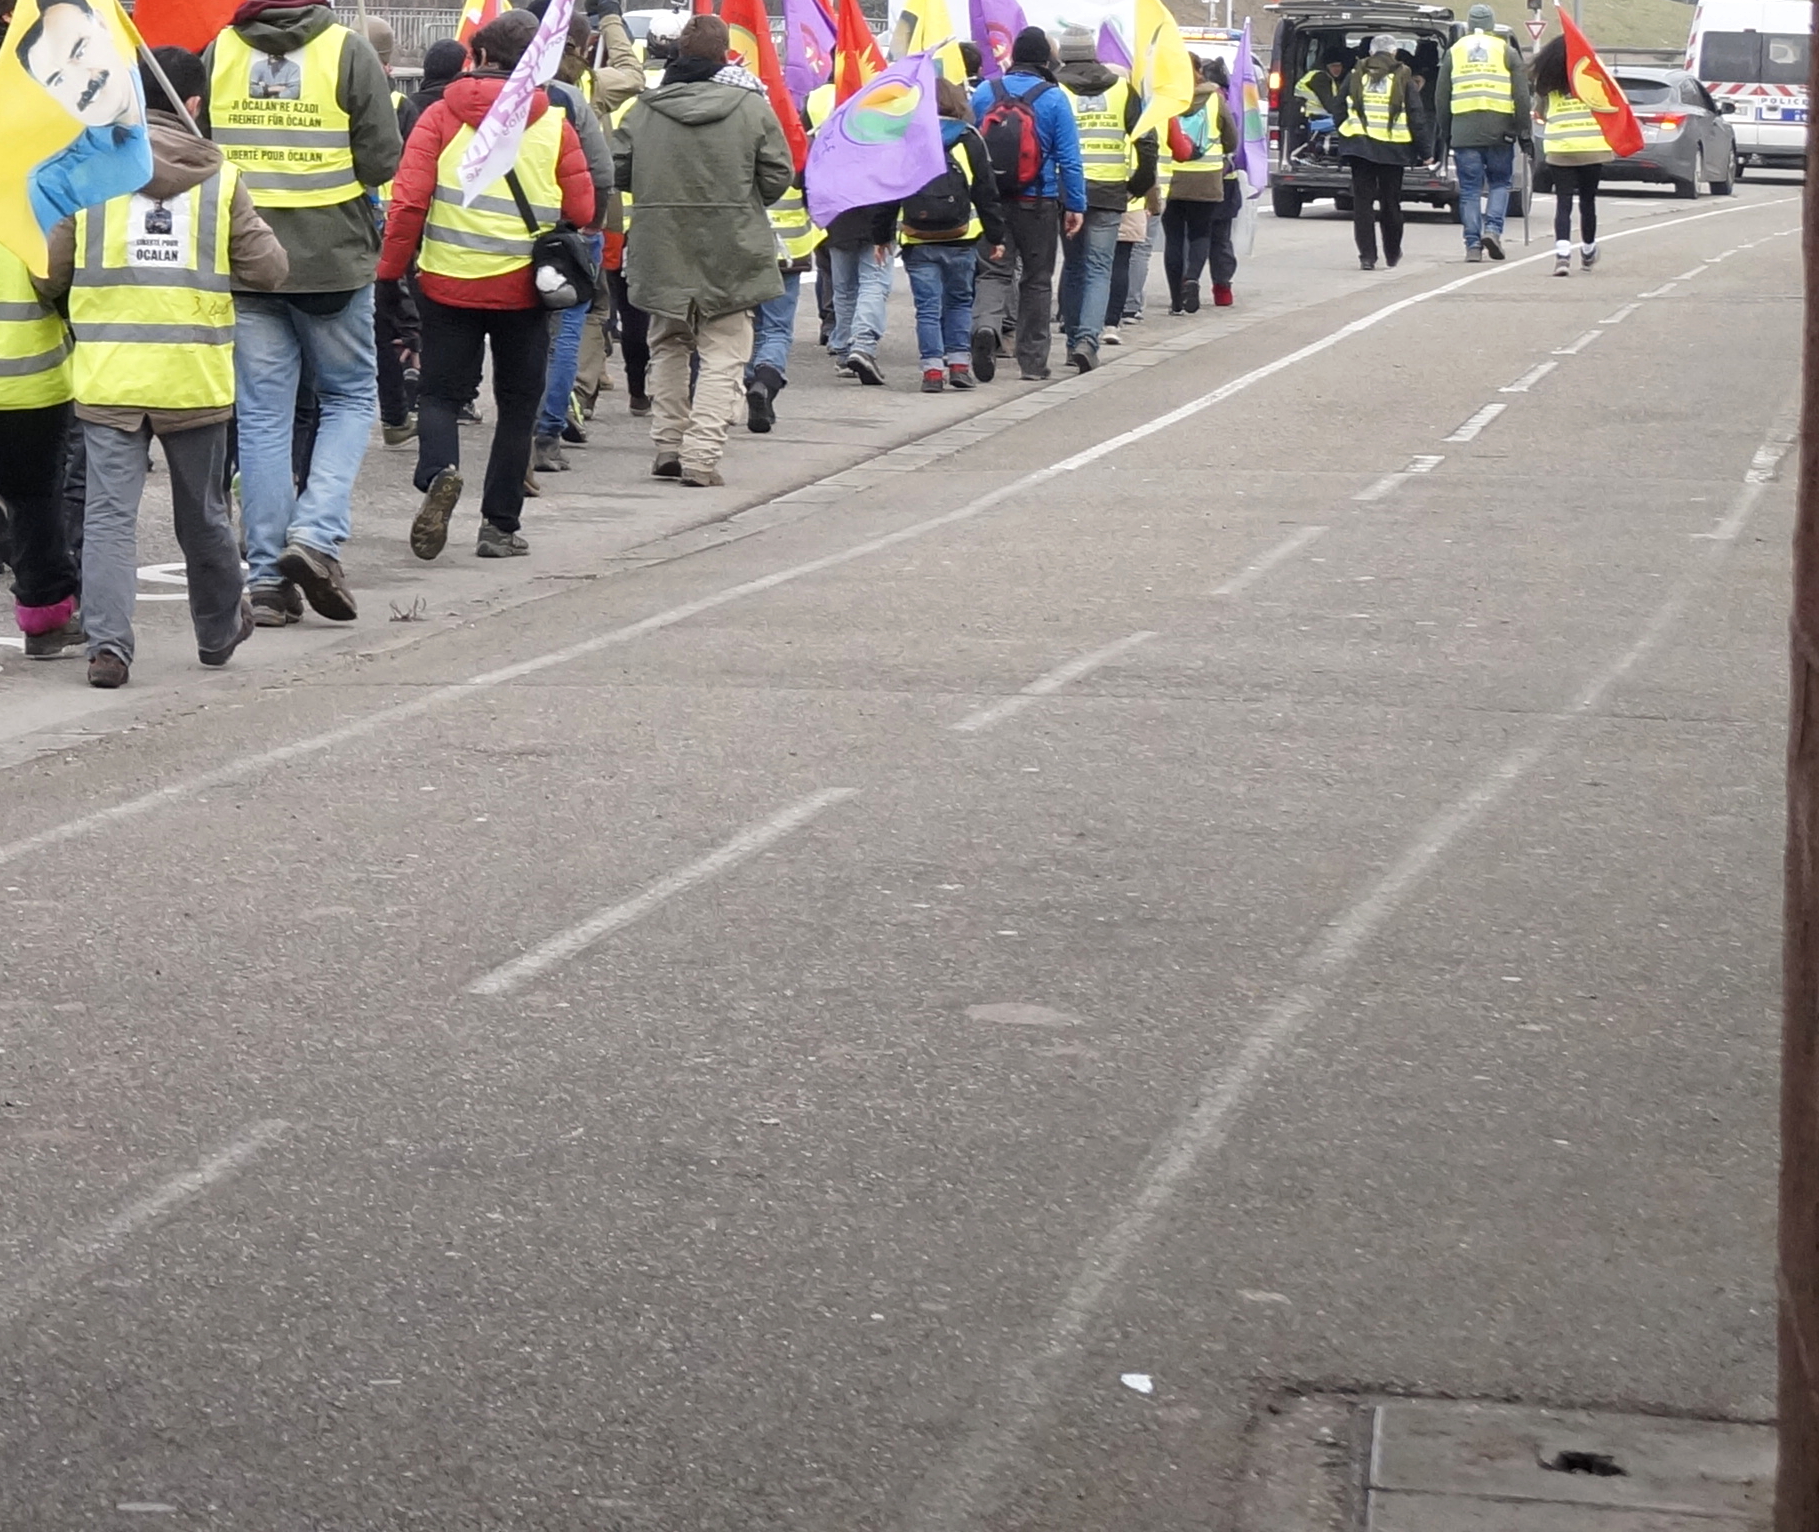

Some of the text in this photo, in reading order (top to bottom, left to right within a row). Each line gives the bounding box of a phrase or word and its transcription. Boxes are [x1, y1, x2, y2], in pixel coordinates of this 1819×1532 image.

[293, 102, 319, 114] AZADI
[228, 114, 265, 126] FREIHEIT
[286, 113, 322, 127] ÖCALAN
[261, 150, 284, 161] POUR
[287, 148, 323, 162] ÖCALAN
